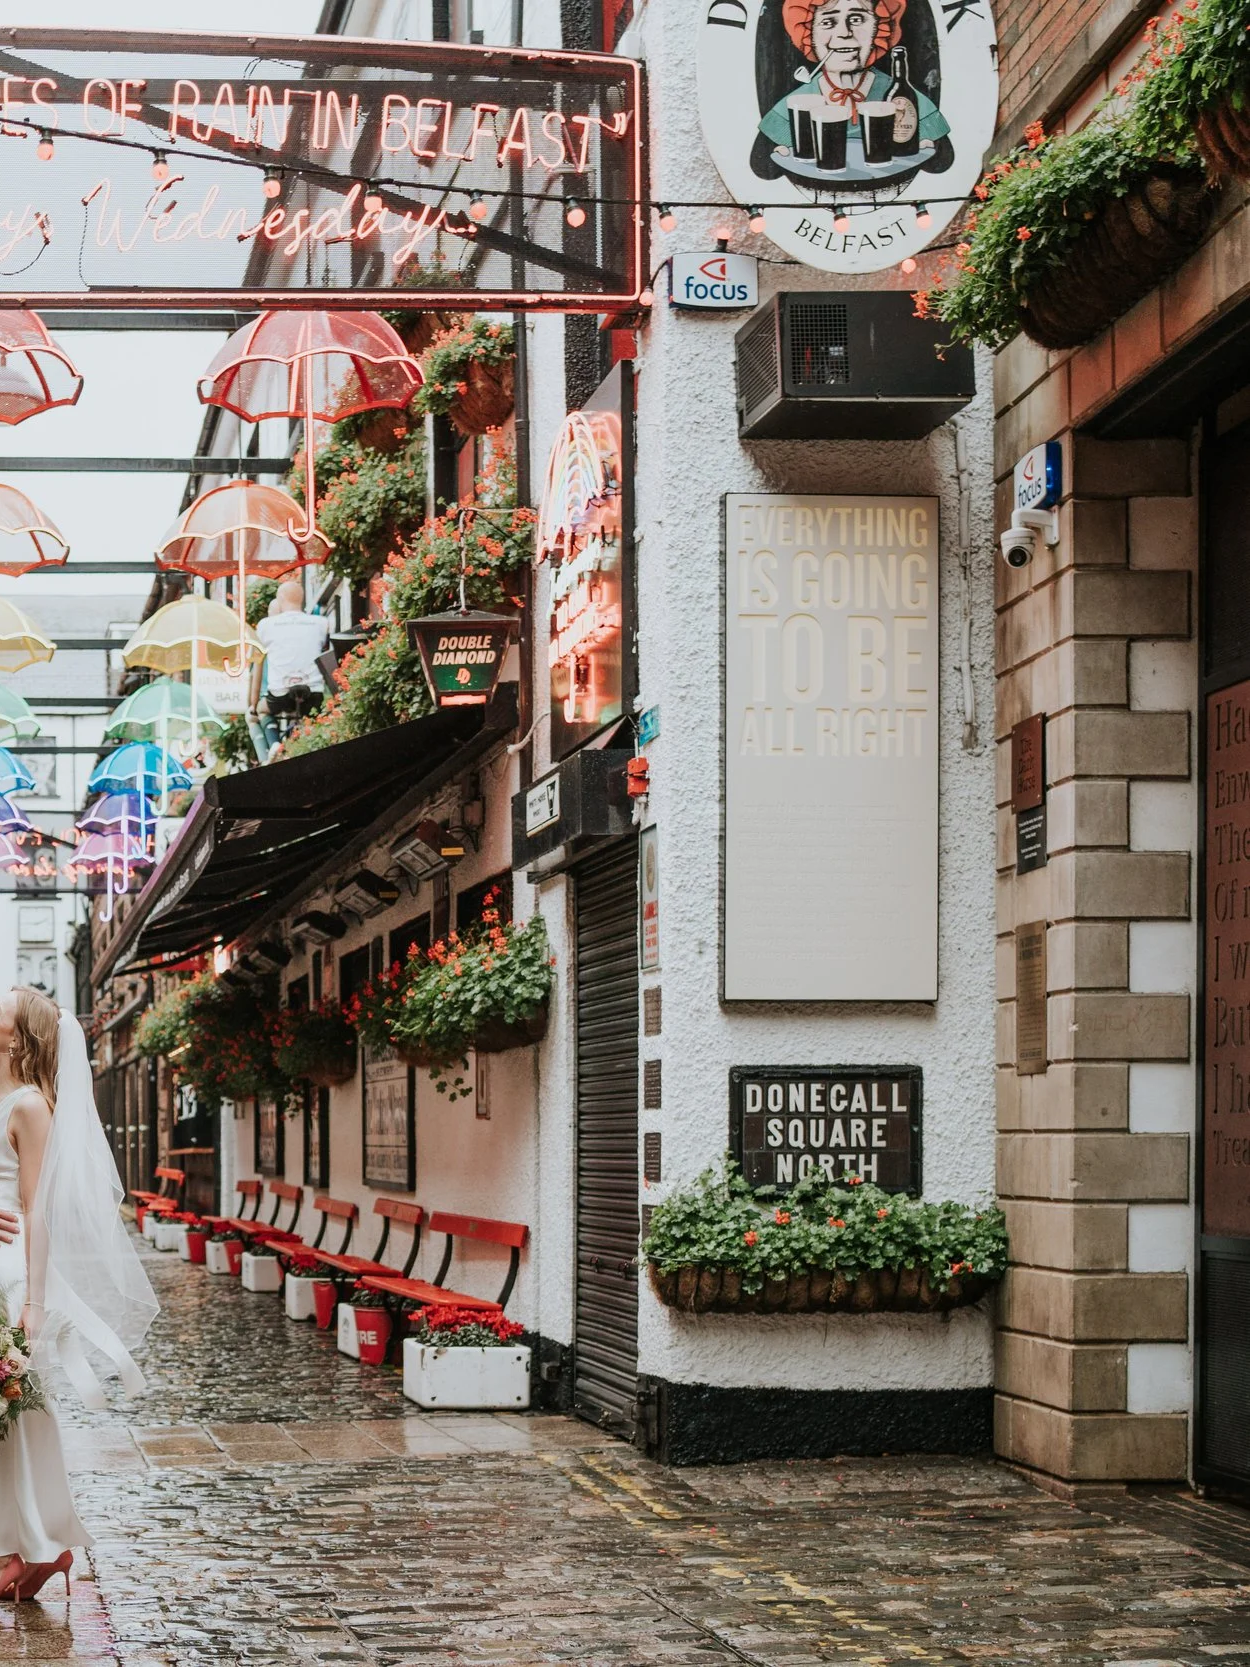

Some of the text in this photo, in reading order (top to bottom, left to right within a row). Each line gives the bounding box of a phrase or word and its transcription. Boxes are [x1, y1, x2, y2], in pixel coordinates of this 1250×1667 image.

[83, 78, 147, 137] OF
[171, 80, 290, 152] RAIN
[312, 90, 358, 150] IN
[794, 218, 910, 254] BELFAST
[684, 276, 748, 301] focus
[1018, 477, 1042, 508] focus
[738, 505, 928, 547] EVERYTHING
[738, 550, 928, 610] IS GOING
[432, 650, 496, 665] DIAMOND
[438, 635, 492, 650] DOUBLE
[738, 613, 928, 702] TO BE
[740, 707, 928, 757] ALL RIGHT
[745, 1083, 908, 1112] DONEGALL
[767, 1118, 887, 1148] SQUARE
[776, 1153, 878, 1183] NORTH
